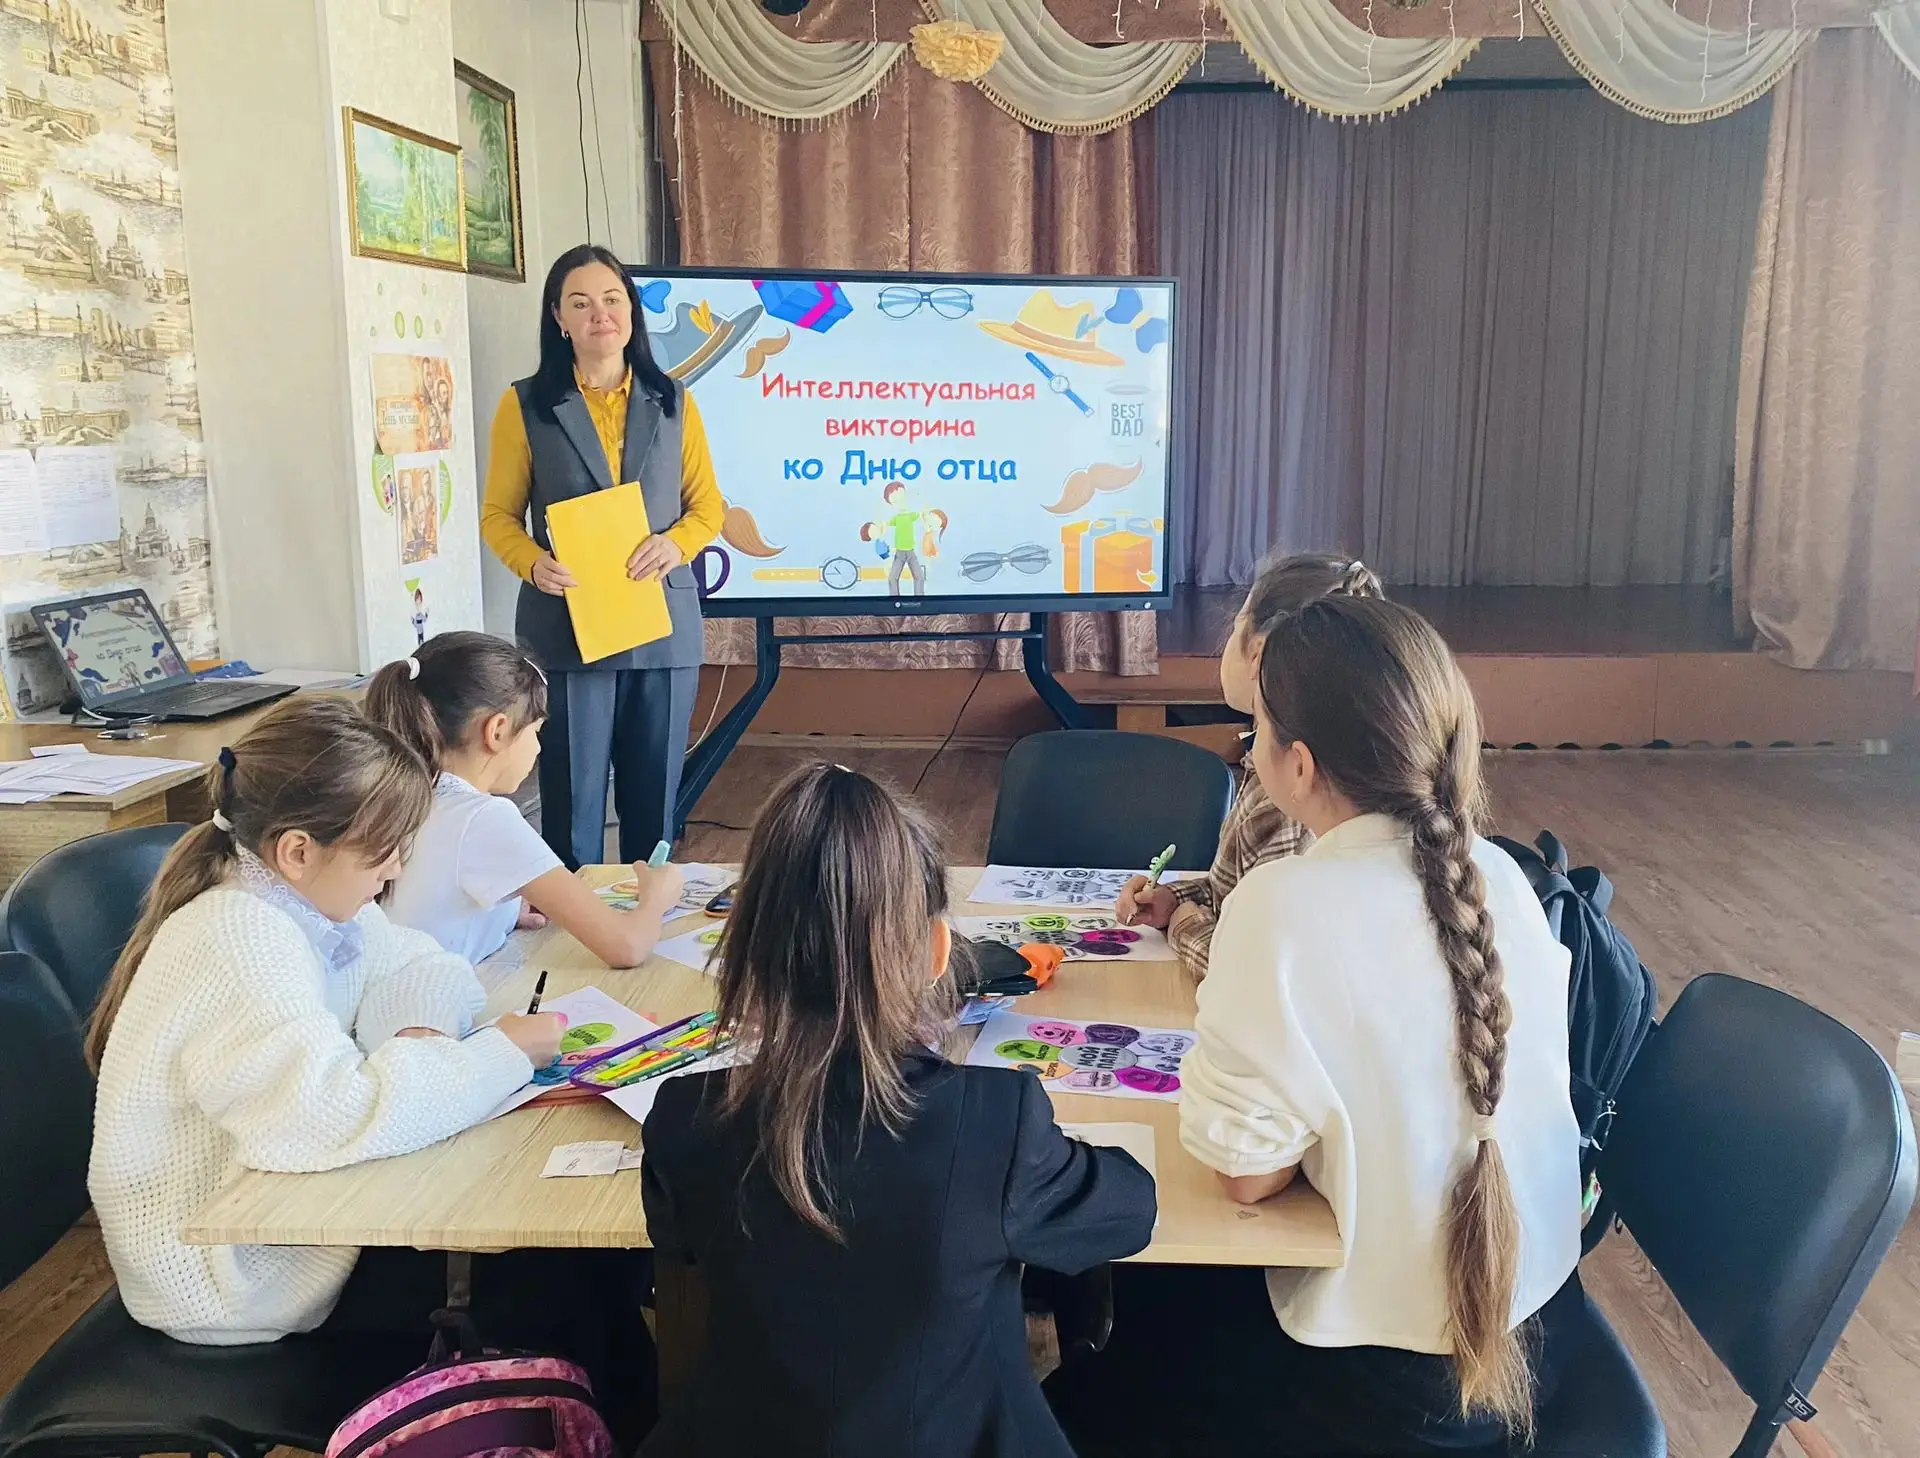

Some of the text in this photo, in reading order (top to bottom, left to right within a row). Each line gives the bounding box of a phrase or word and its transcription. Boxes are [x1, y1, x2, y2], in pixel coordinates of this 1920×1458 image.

[762, 372, 1035, 407] Интеллектуальная
[1111, 403, 1144, 419] BEST
[825, 418, 976, 443] викторина
[1111, 418, 1144, 437] DAD
[783, 450, 1018, 486] ко Дню отца
[1078, 1045, 1100, 1067] МОЙ
[1096, 1047, 1121, 1070] ПАПА
